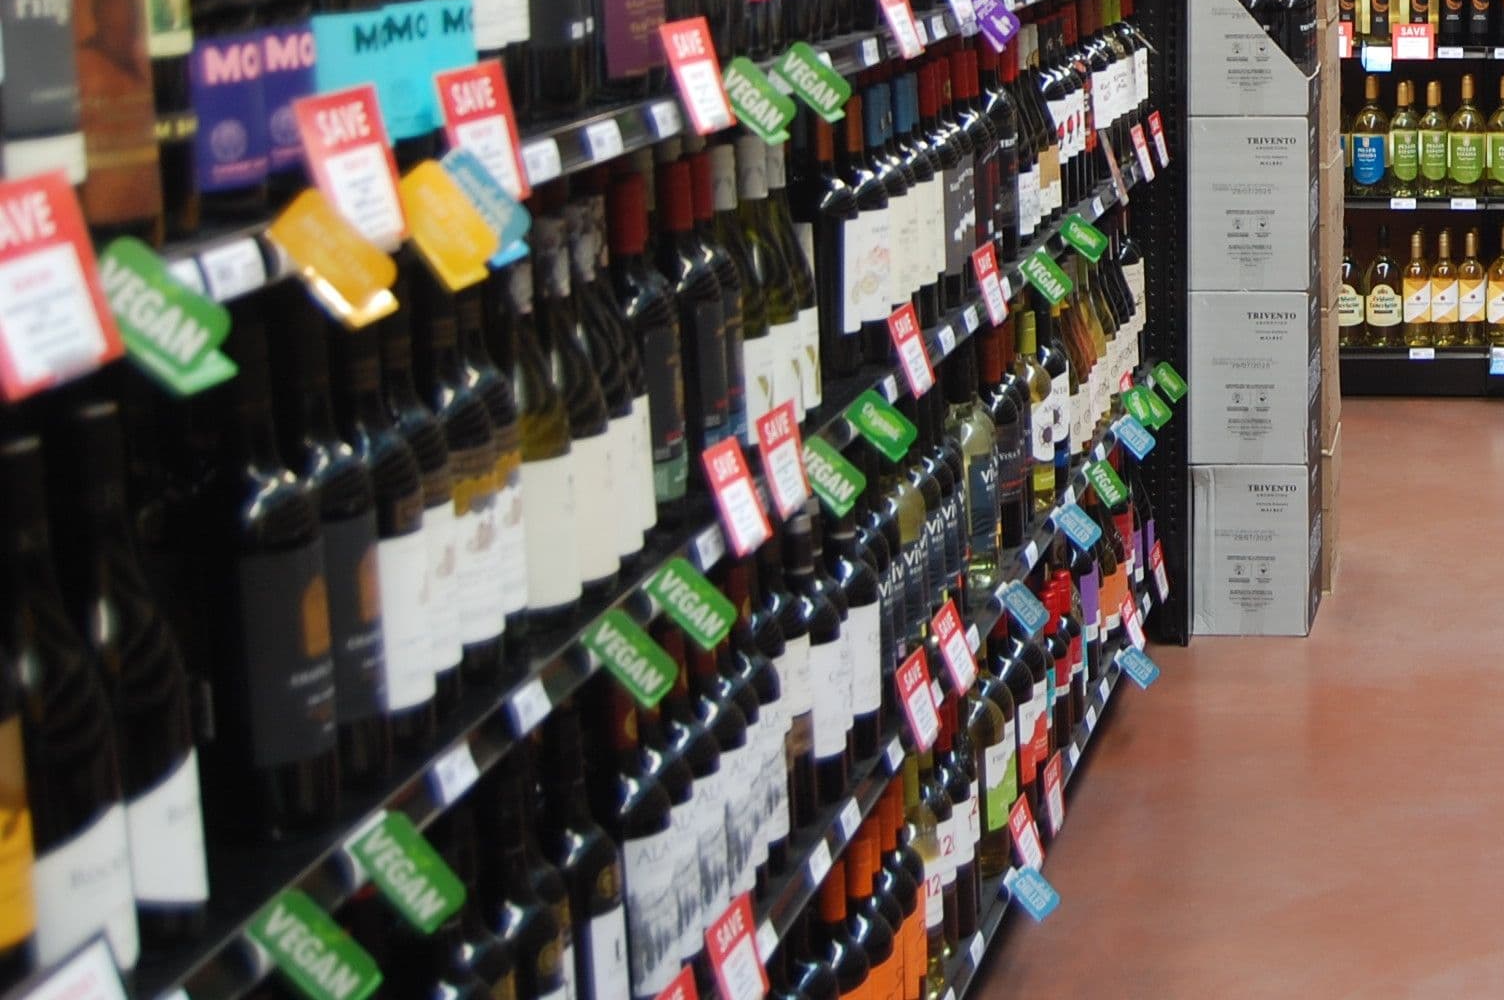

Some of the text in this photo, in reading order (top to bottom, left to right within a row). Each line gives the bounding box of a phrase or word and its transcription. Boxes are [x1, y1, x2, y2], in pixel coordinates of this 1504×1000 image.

[672, 30, 705, 59] SAVE
[1401, 27, 1426, 36] SAVE
[450, 78, 496, 116] SAVE
[723, 69, 784, 129] VEGAN
[782, 52, 838, 109] VEGAN
[316, 101, 372, 144] SAVE
[1247, 137, 1296, 145] TRIVENTO
[975, 251, 993, 271] SAVE
[1028, 259, 1065, 298] VEGAN
[100, 255, 210, 367] VEGAN
[896, 313, 914, 341] SAVE
[1247, 312, 1296, 320] TRIVENTO
[764, 412, 790, 442] SAVE
[862, 402, 902, 441] Organic
[713, 450, 740, 480] SAVE
[803, 447, 855, 500] VEGAN
[1092, 465, 1121, 504] VEGAN
[656, 570, 727, 635] VEGAN
[938, 612, 956, 636] SAVE
[593, 621, 667, 698] VEGAN
[904, 664, 922, 690] SAVE
[1046, 767, 1060, 785] SAVE
[1012, 807, 1027, 832] SAVE
[357, 826, 449, 928] VEGAN
[716, 907, 746, 952] SAVE
[262, 904, 360, 999] VEGAN
